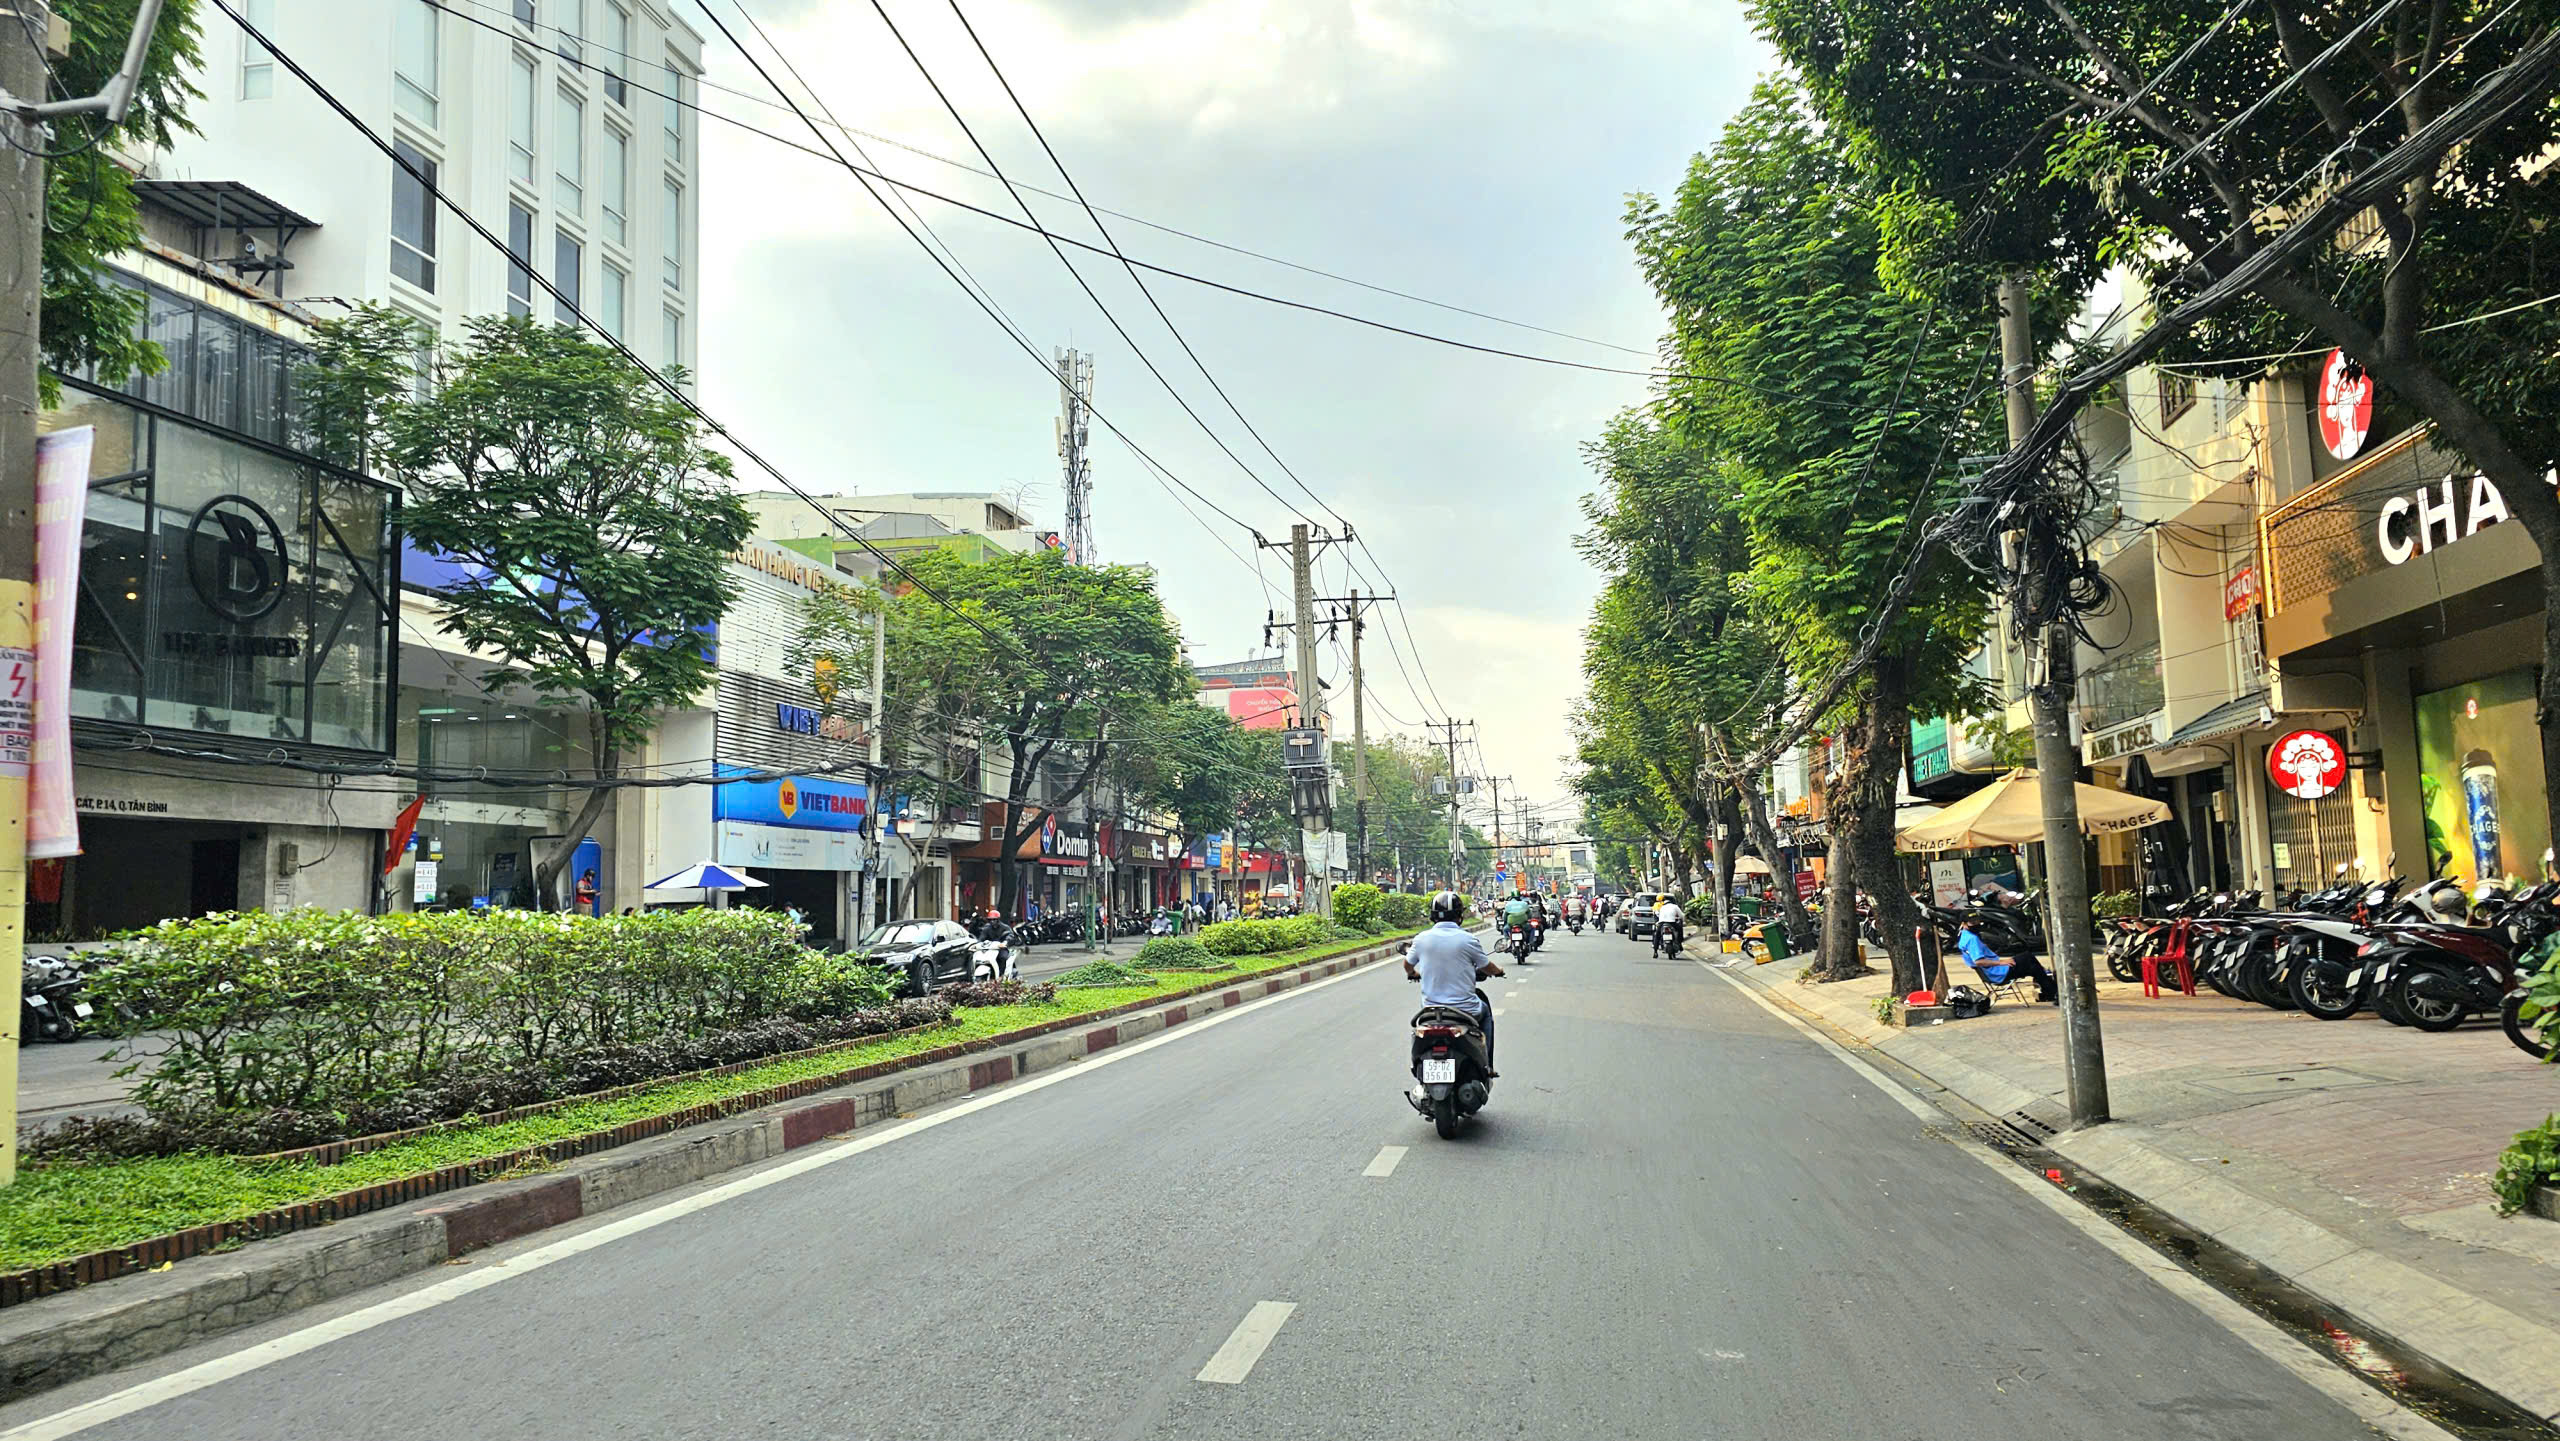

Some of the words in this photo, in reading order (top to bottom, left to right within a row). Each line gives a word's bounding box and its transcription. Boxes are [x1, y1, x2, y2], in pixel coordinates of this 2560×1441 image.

[2378, 469, 2509, 565] CHA
[800, 791, 867, 815] VIETBANK
[1056, 829, 1089, 858] Domin
